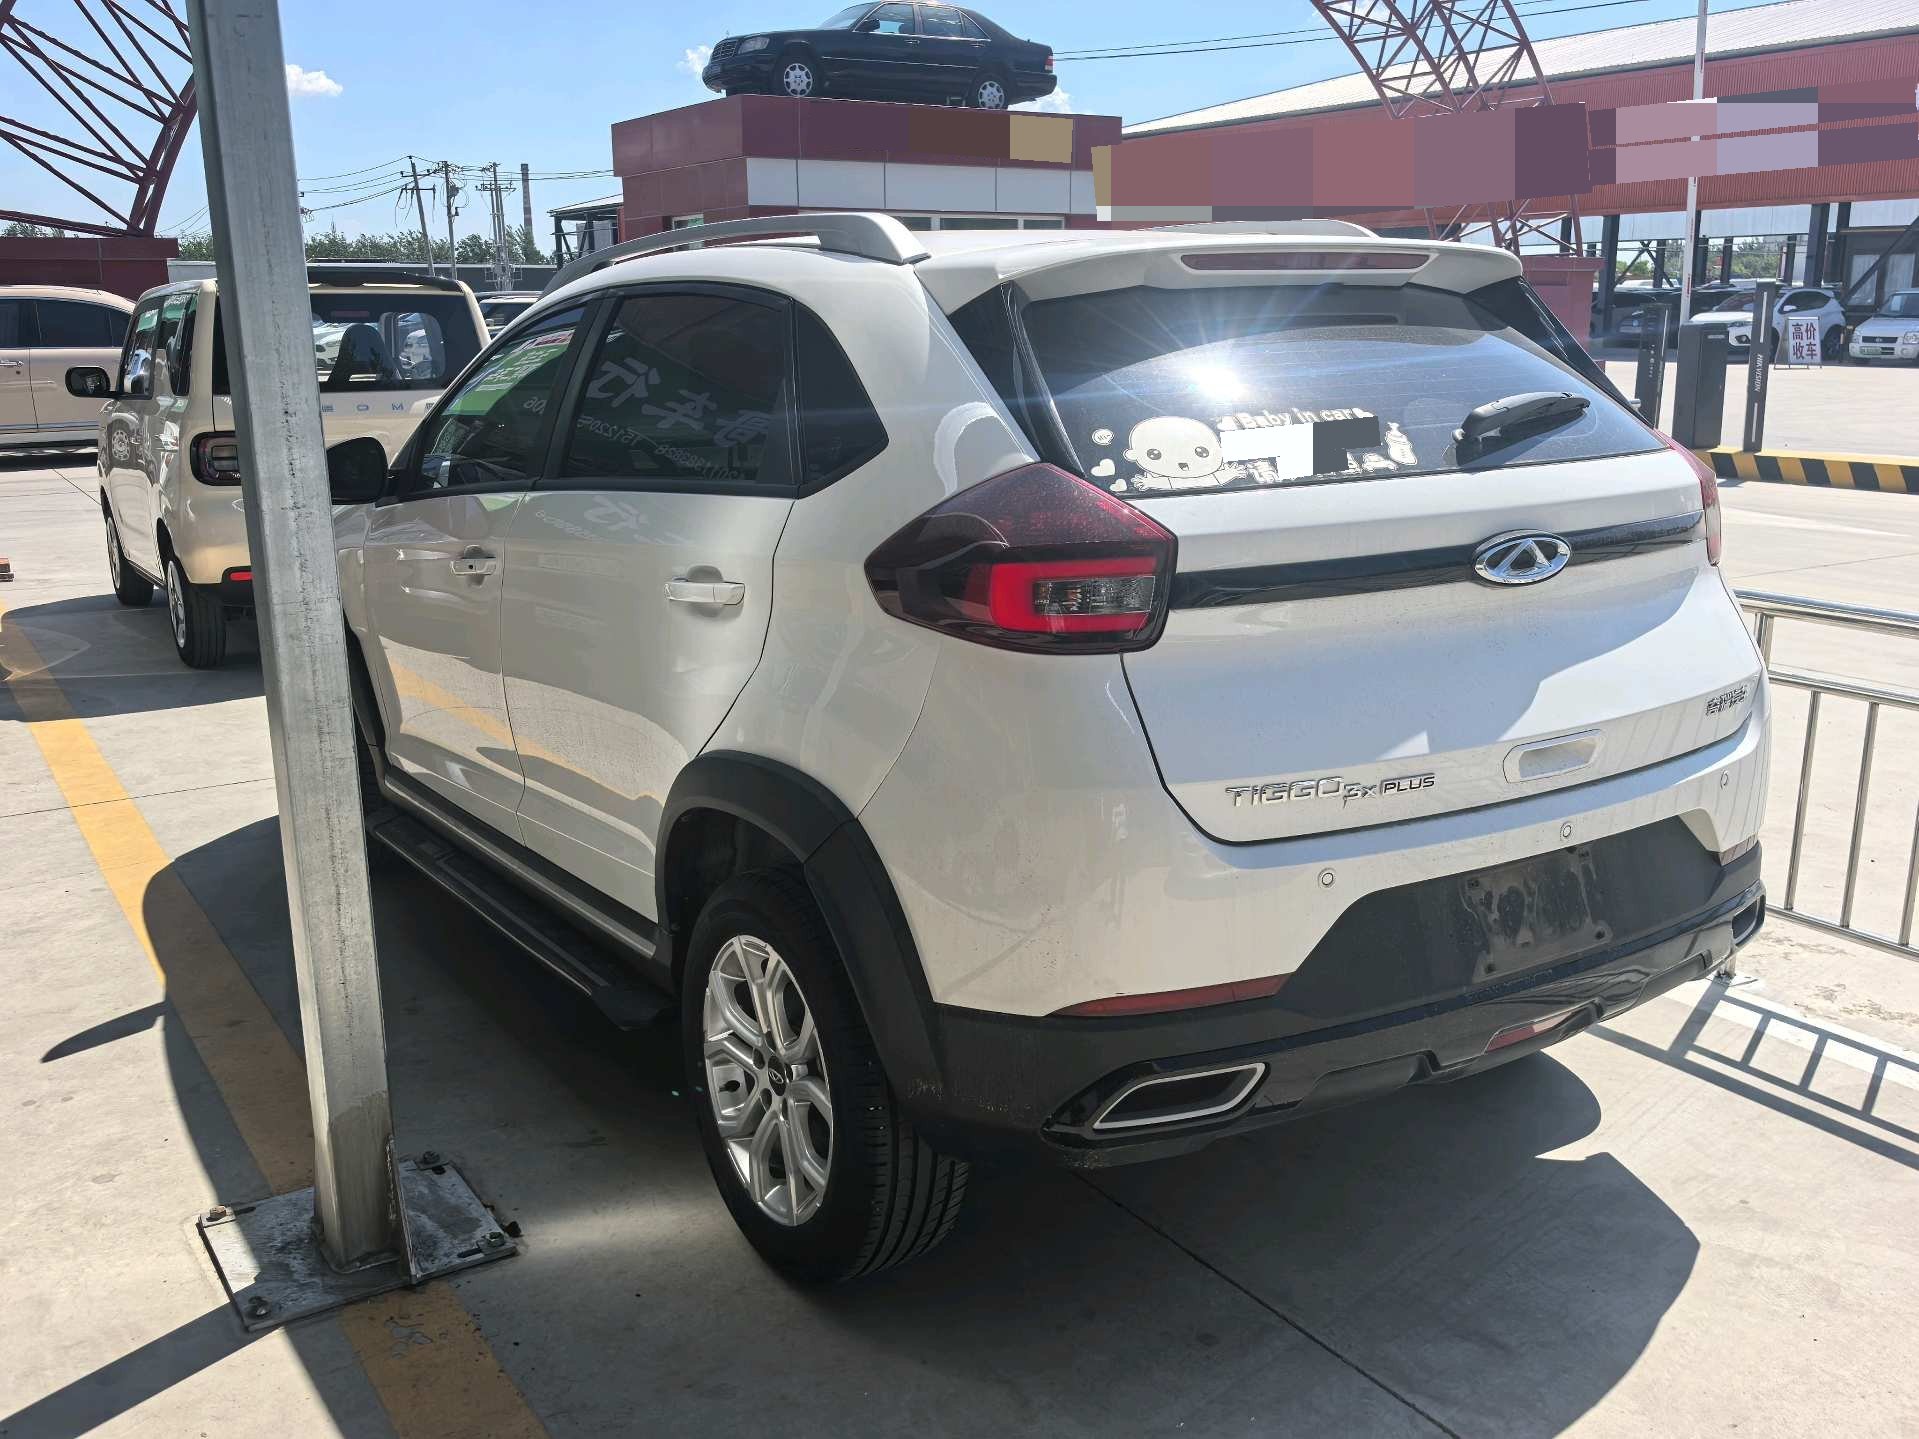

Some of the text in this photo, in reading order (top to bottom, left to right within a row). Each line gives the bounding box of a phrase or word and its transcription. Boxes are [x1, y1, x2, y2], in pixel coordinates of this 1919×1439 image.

[1791, 322, 1817, 341] 高价
[1792, 341, 1817, 360] 收车
[1754, 353, 1764, 392] HIKVISION
[1236, 409, 1291, 430] Baby
[1225, 776, 1344, 807] TIGGO
[1382, 773, 1435, 795] PLUS
